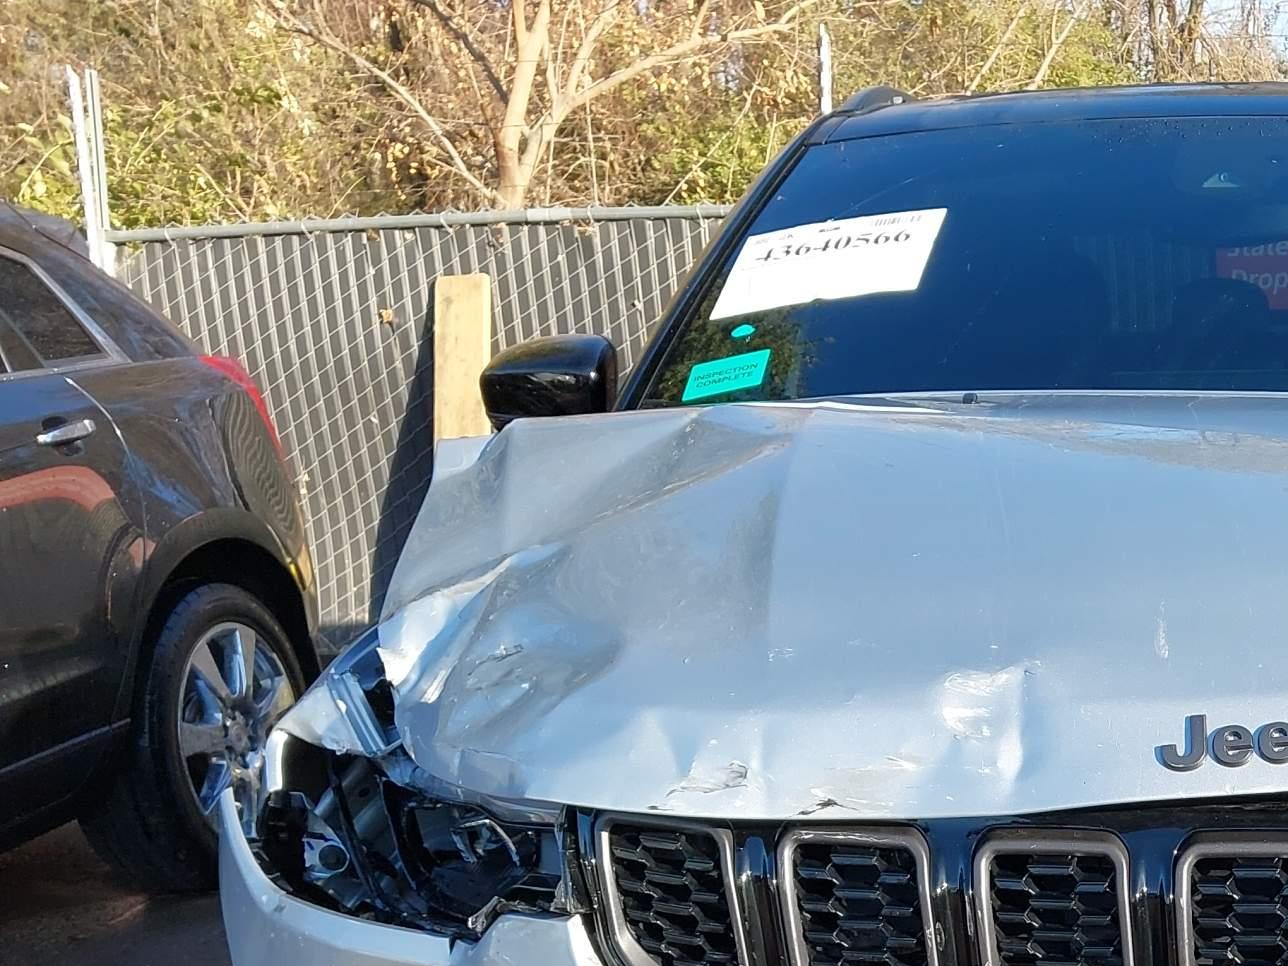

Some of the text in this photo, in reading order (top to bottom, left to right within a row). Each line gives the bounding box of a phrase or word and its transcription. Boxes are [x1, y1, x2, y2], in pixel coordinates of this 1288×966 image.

[756, 230, 911, 261] 43640566
[694, 362, 760, 382] INSPECTION
[695, 371, 754, 389] COMPLETE
